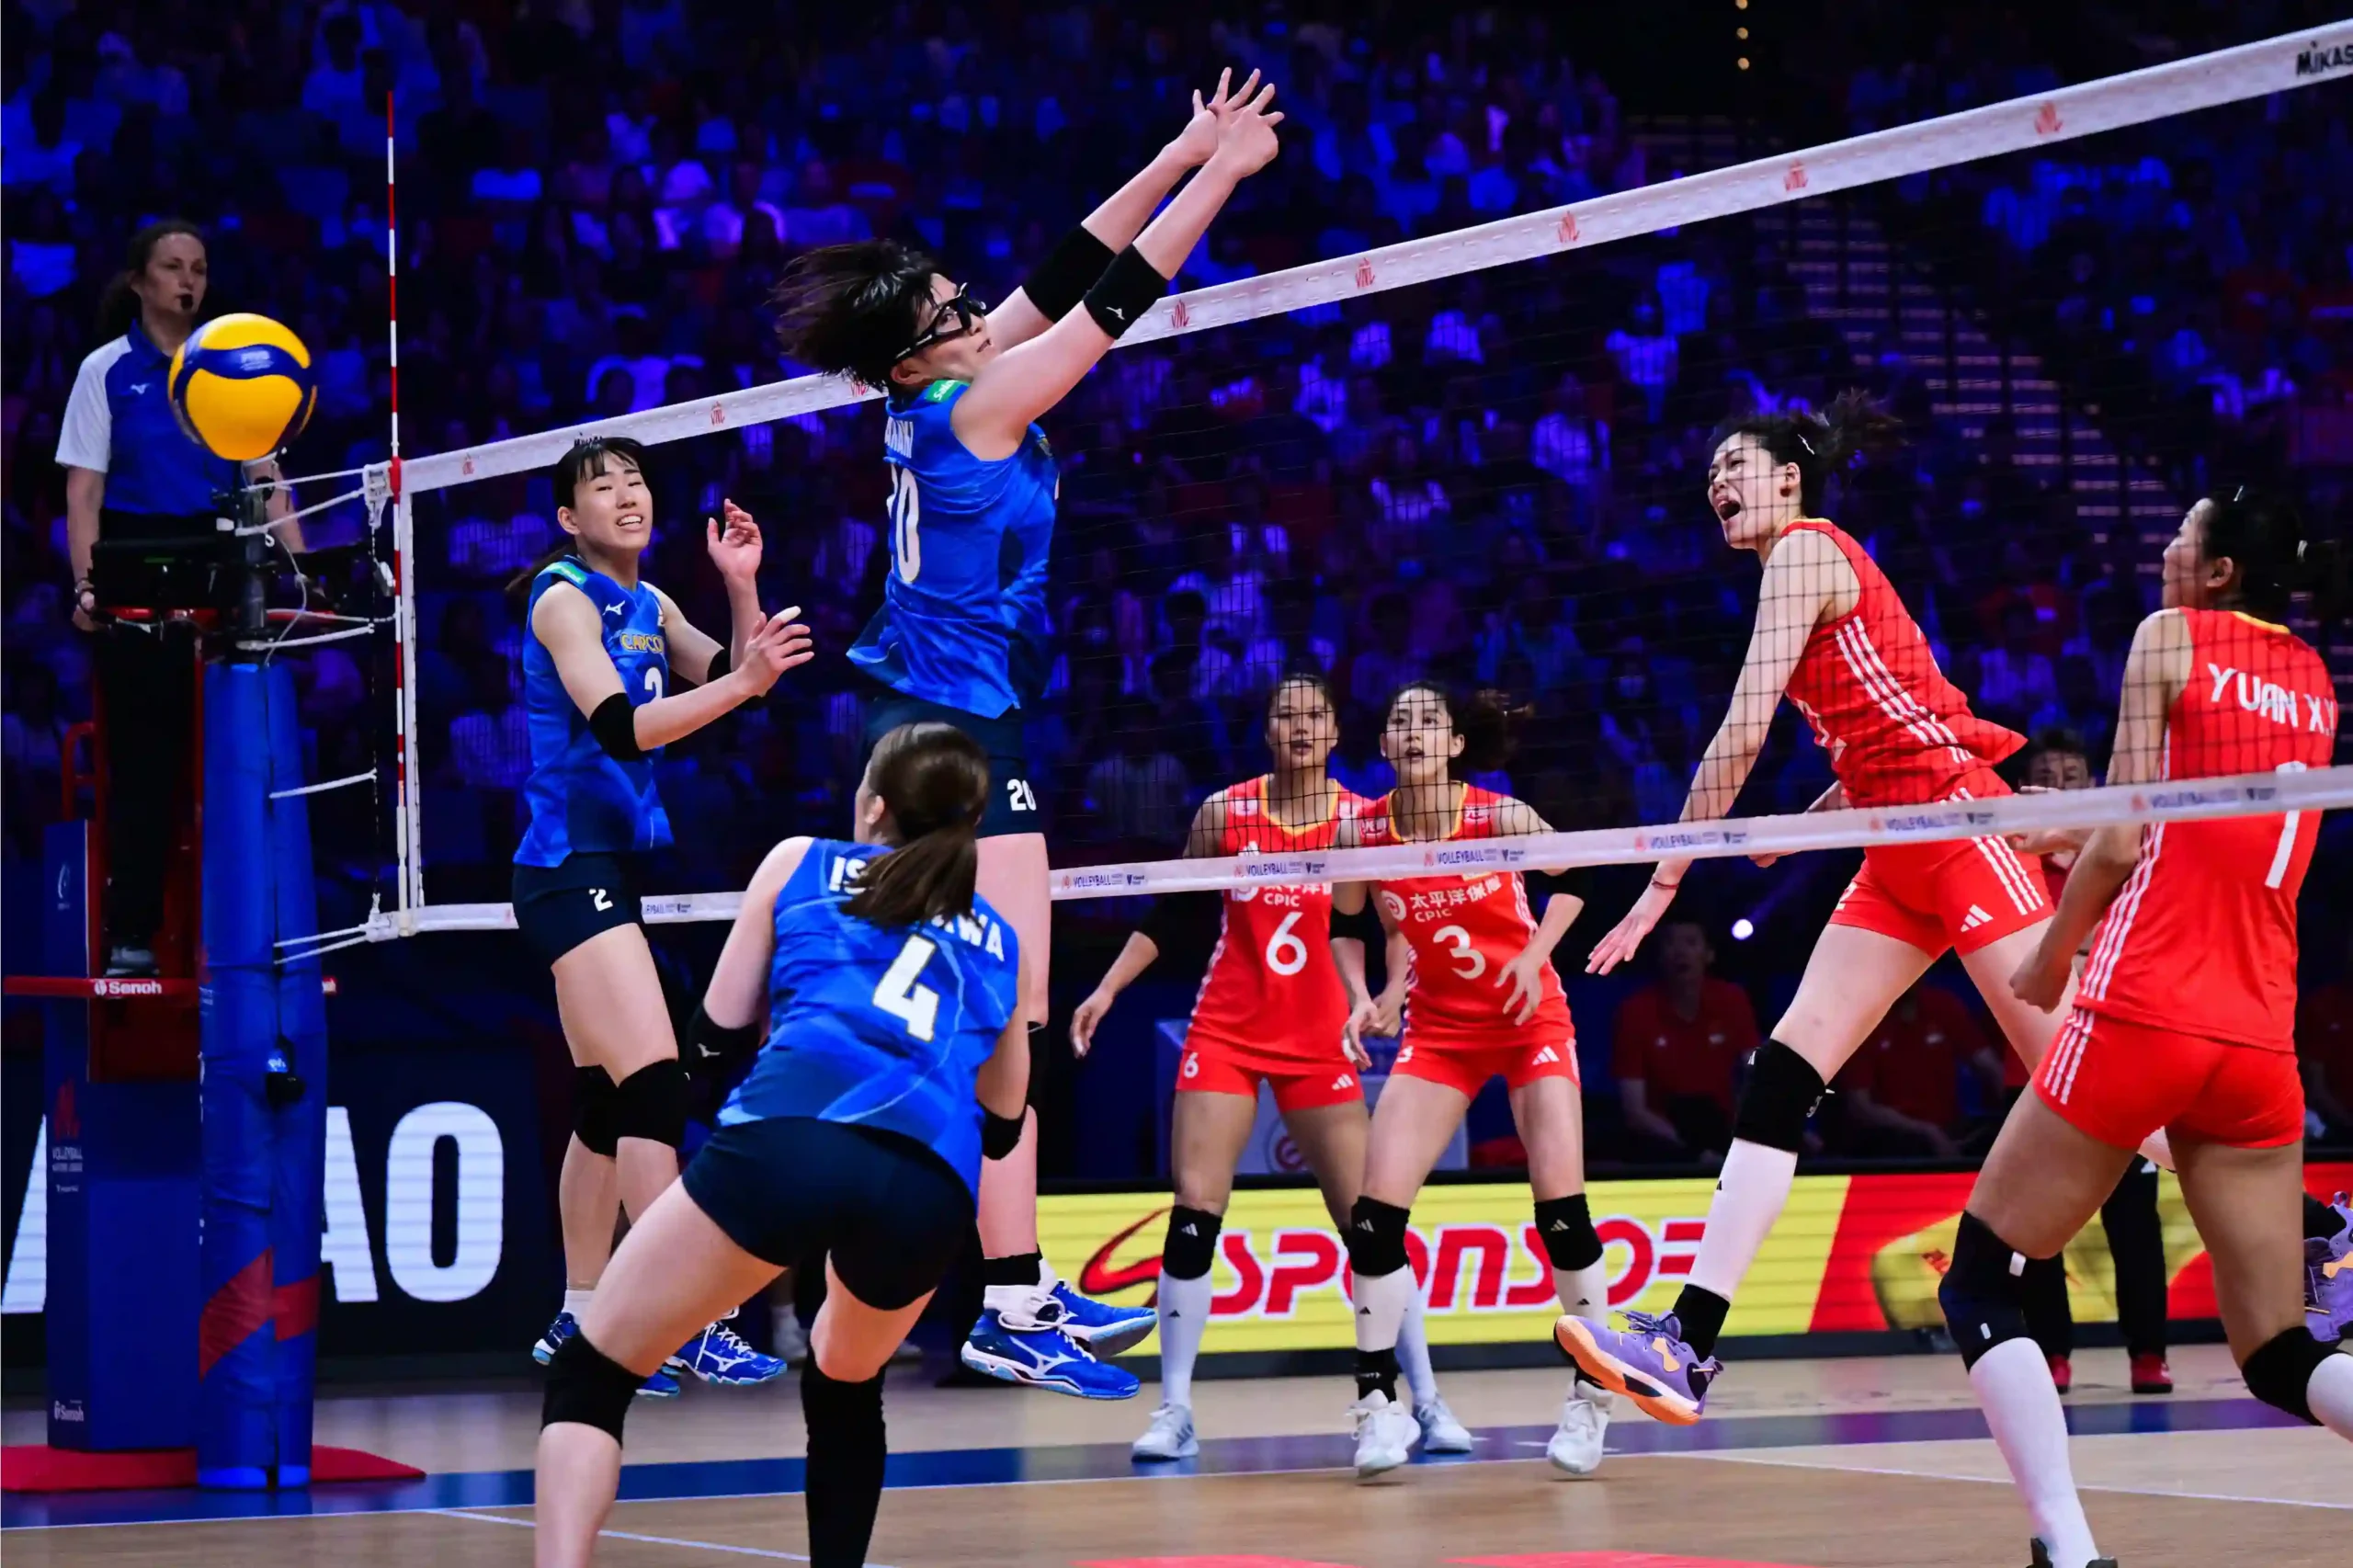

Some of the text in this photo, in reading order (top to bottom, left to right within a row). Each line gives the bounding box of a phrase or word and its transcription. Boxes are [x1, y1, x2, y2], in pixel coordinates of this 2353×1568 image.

[620, 632, 665, 653] CAPCO
[2208, 663, 2299, 728] YUAN
[1006, 778, 1037, 811] 20
[1436, 849, 1484, 865] VOLLEYBALL
[1073, 873, 1111, 888] VOLLEYBALL
[1246, 862, 1288, 877] VOLLEYBALL
[588, 888, 613, 911] 2
[1263, 892, 1301, 907] CPIC
[1415, 907, 1452, 923] CPIC
[1266, 912, 1307, 976] 6
[1433, 925, 1486, 980] 3
[108, 981, 163, 995] Senoh
[872, 934, 939, 1042] 4
[1184, 1051, 1199, 1079] 6
